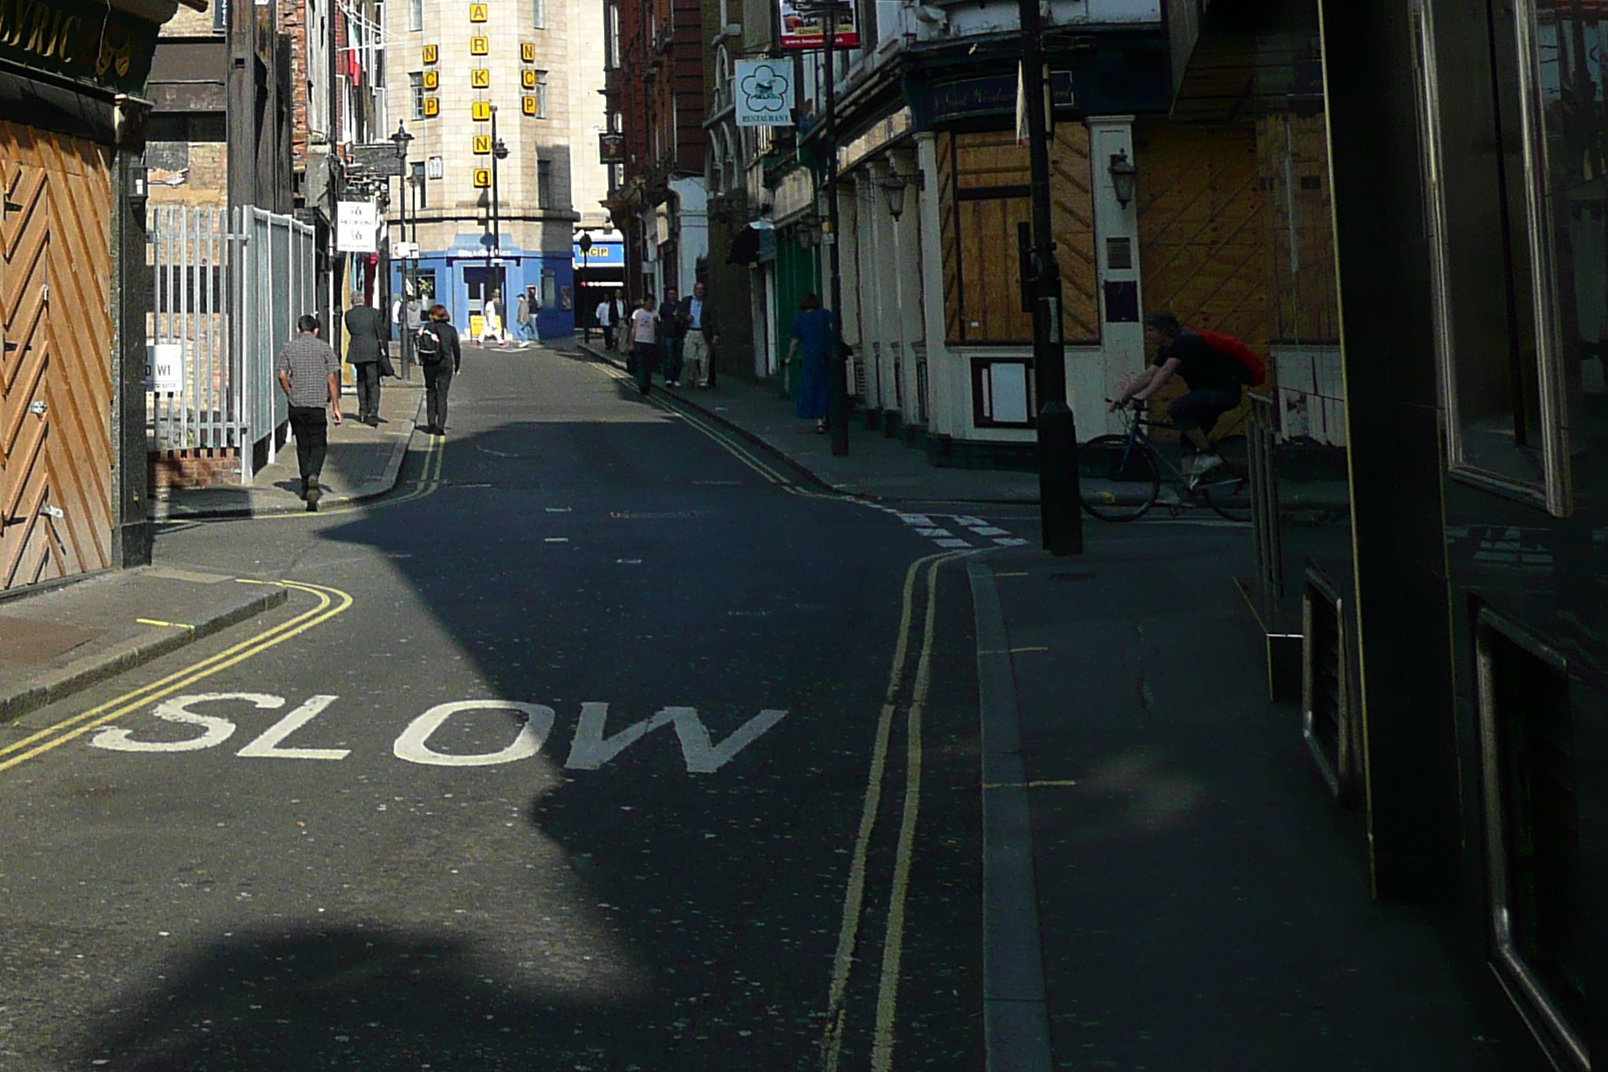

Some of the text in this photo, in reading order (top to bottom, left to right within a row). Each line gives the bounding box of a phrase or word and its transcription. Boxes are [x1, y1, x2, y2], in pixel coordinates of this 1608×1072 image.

[424, 46, 437, 114] NCP
[523, 45, 536, 112] NCP
[157, 364, 170, 376] W1
[93, 693, 789, 773] SLOW
